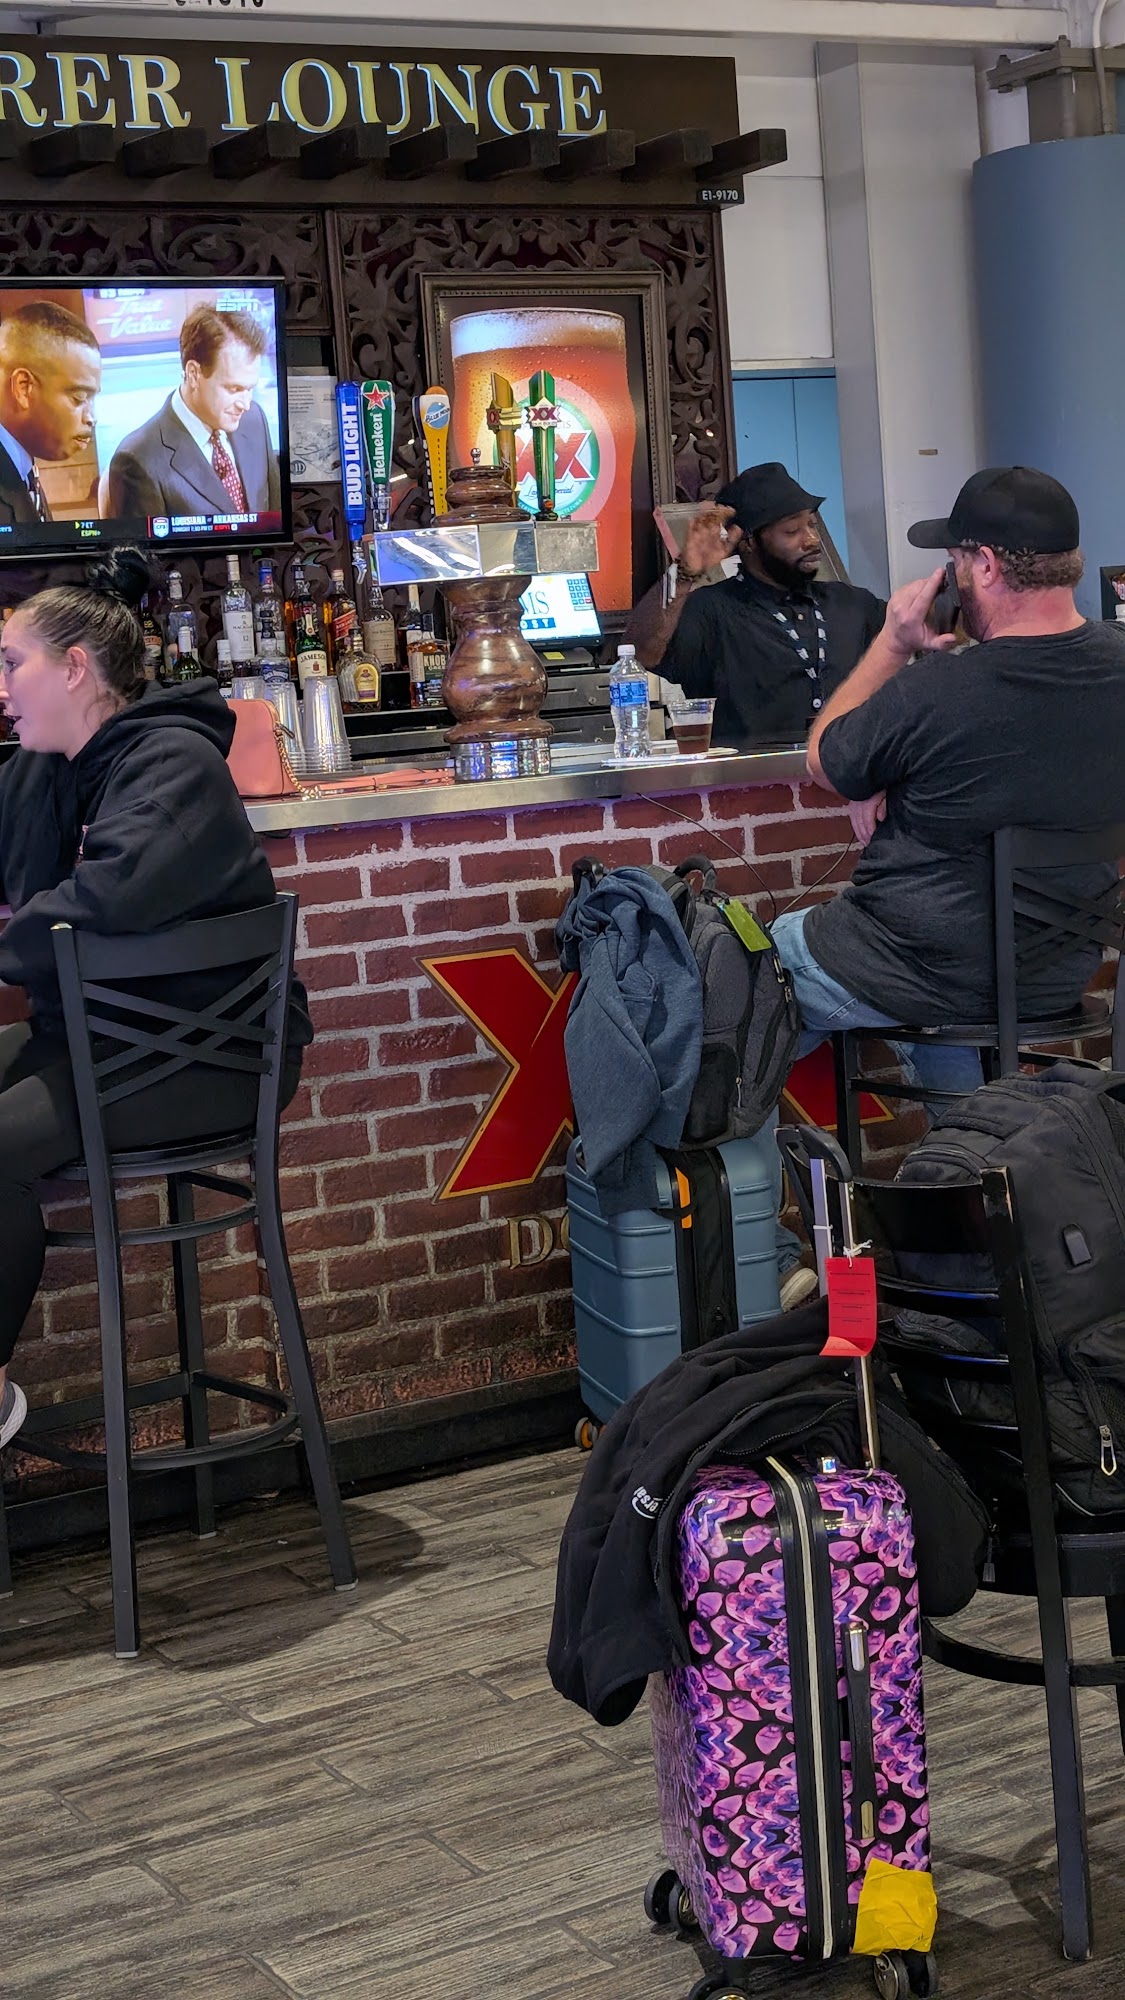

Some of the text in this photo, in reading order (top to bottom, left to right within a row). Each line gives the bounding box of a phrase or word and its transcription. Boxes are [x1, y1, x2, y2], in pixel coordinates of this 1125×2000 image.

[214, 57, 607, 136] LOUNGE
[701, 190, 739, 201] E1-9170
[341, 403, 363, 506] BUD LIGHT
[371, 412, 386, 479] Heineken
[300, 653, 325, 663] JAMESO
[423, 654, 447, 667] KNOB
[633, 1485, 660, 1512] ersal
